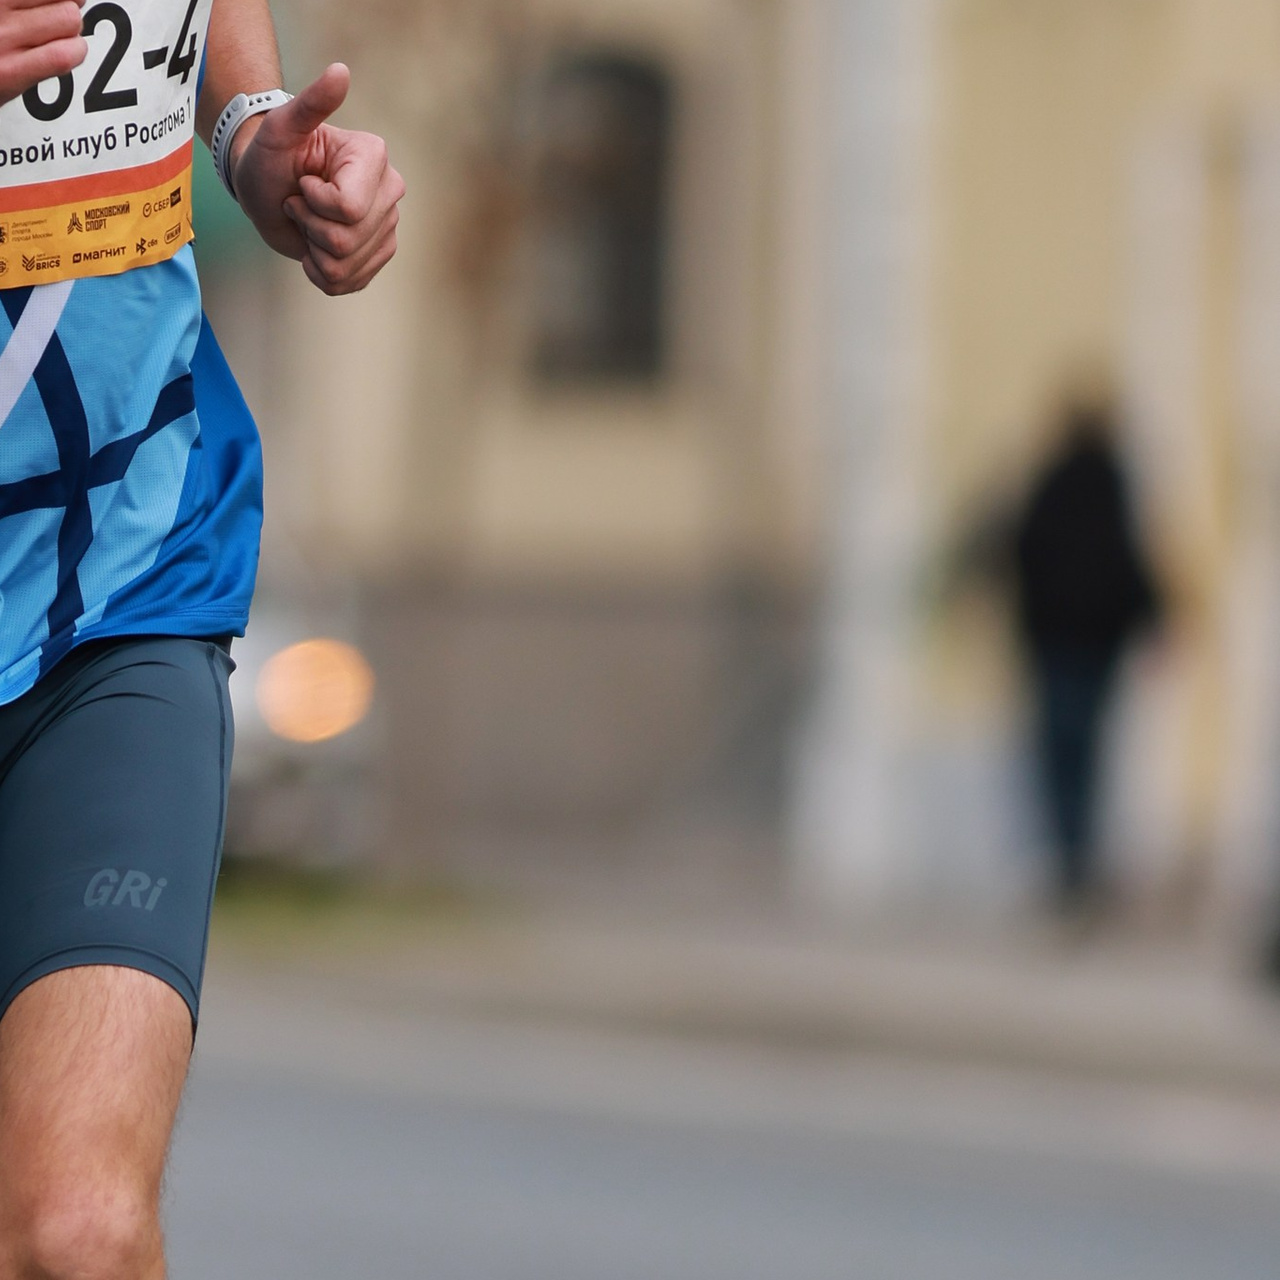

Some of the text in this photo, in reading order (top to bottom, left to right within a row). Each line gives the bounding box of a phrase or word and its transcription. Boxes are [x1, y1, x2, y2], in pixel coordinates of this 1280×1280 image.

[63, 125, 117, 159] клуб
[124, 107, 186, 147] Росатома
[84, 201, 131, 220] МОСКОВСКИЙ
[153, 197, 170, 213] СБЕР
[85, 219, 108, 232] СПОРТ
[35, 259, 61, 271] BRICS
